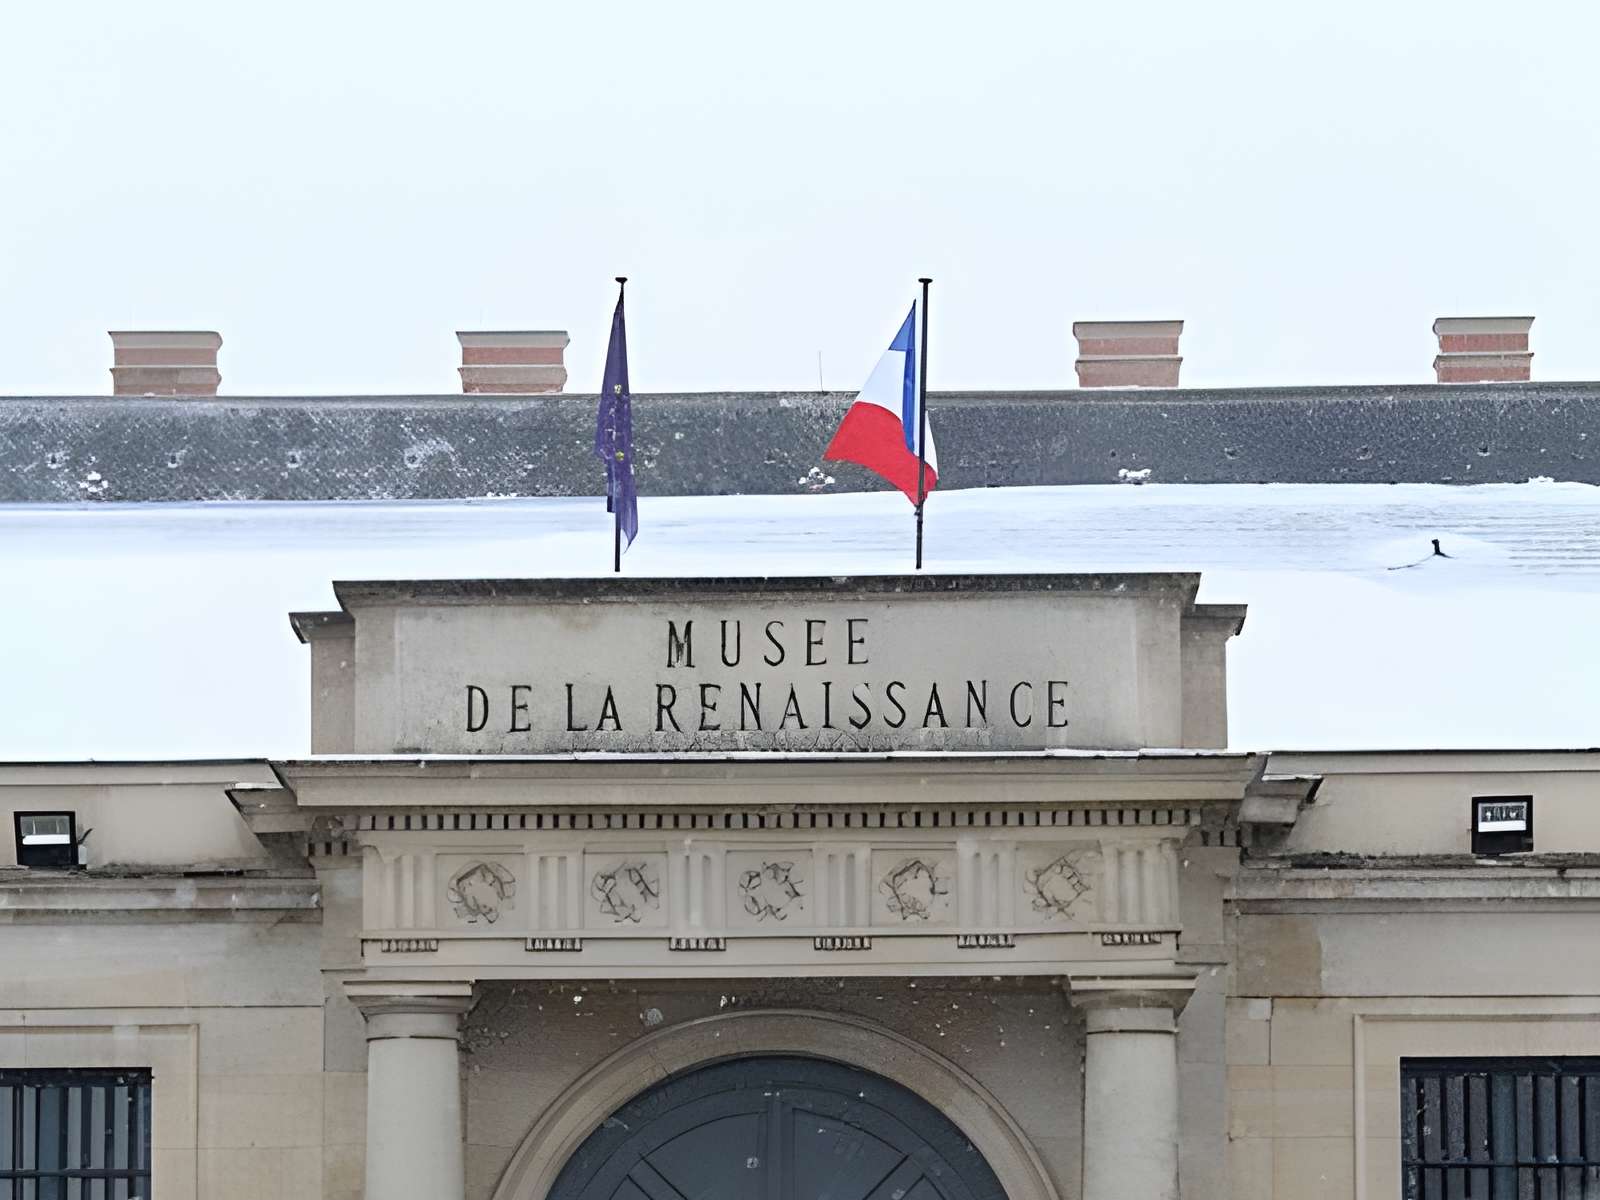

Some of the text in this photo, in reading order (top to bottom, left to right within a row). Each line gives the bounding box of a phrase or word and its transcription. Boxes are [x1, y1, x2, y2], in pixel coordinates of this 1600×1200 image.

[666, 618, 870, 669] MUSEE
[465, 679, 1070, 734] DE LA RENAISSANCE
